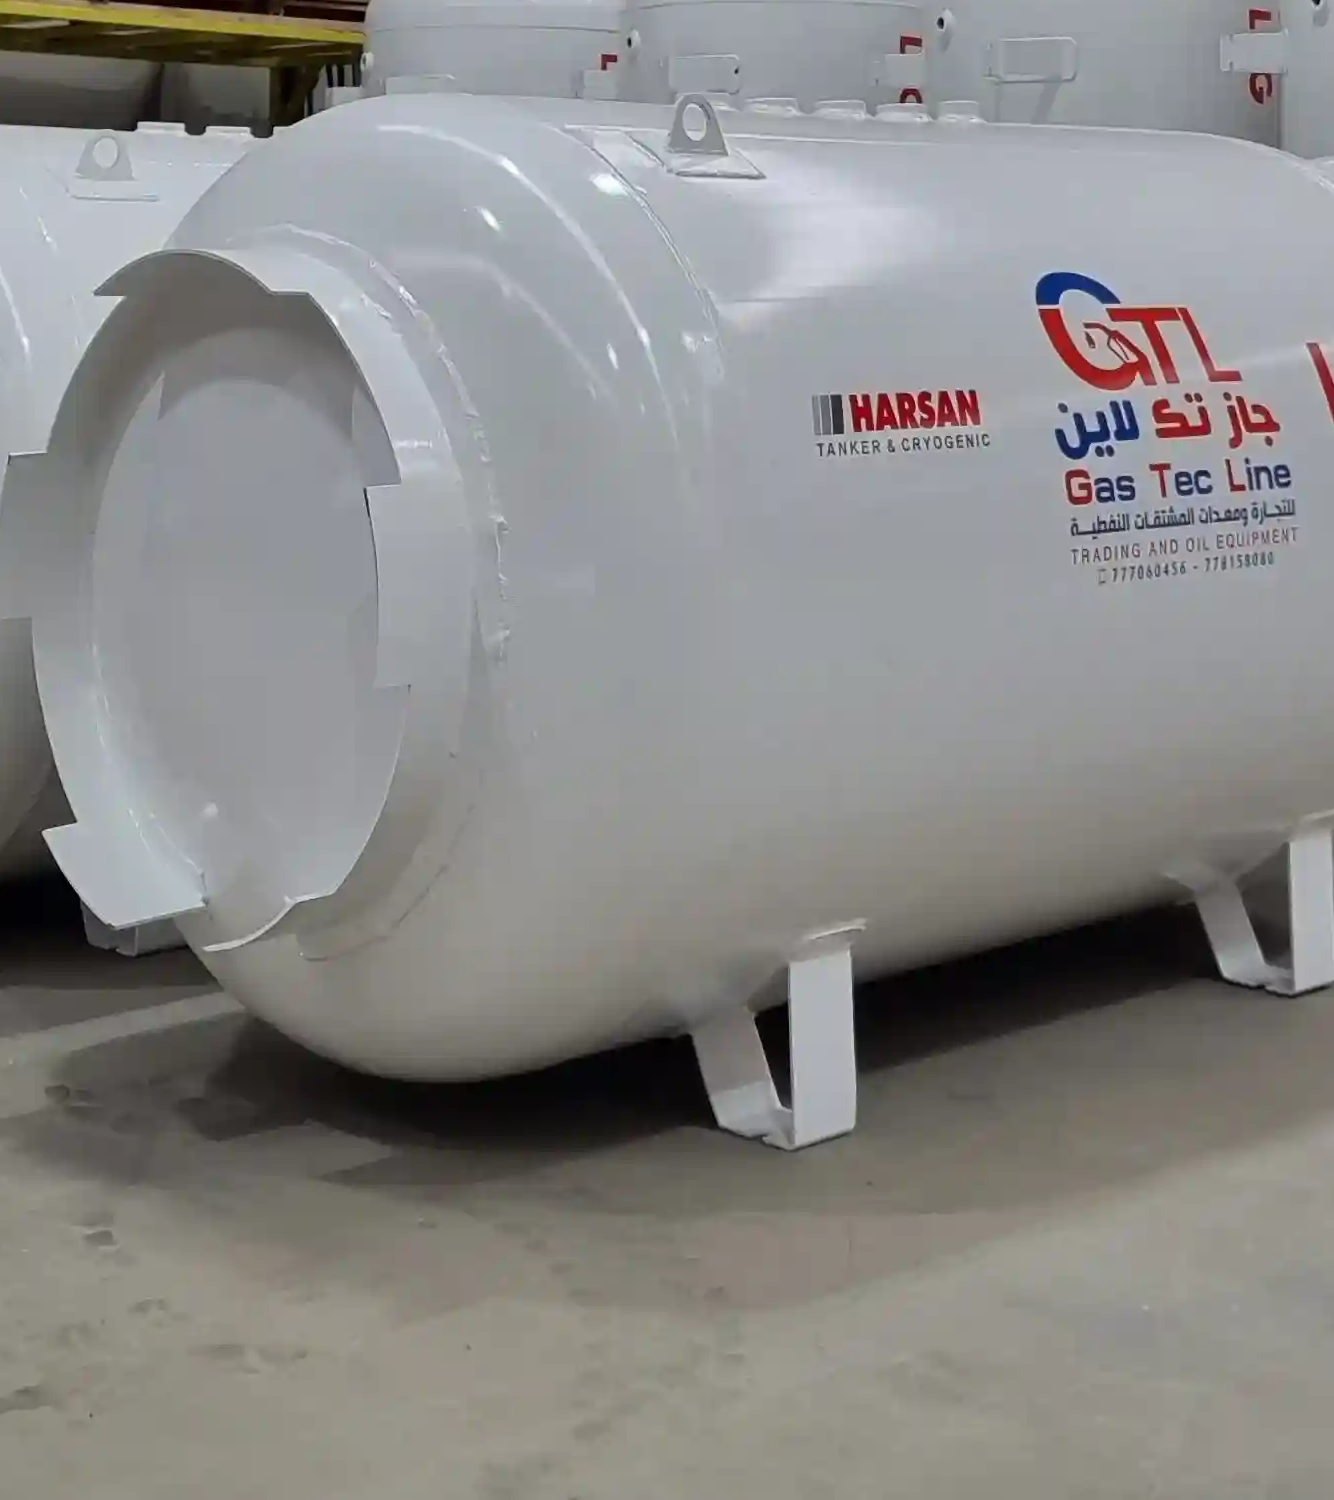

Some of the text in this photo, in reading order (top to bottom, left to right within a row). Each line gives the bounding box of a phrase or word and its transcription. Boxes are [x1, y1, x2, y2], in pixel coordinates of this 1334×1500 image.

[1035, 271, 1243, 391] GTL
[848, 389, 982, 433] HARSAN
[1054, 399, 1140, 461] لاين
[1222, 391, 1282, 450] جاز
[816, 433, 992, 458] TANKER & CRYOGENIC
[1064, 456, 1293, 506] Gas Tec Line
[1069, 526, 1301, 566] TRADING AND OIL EQUIPMENT
